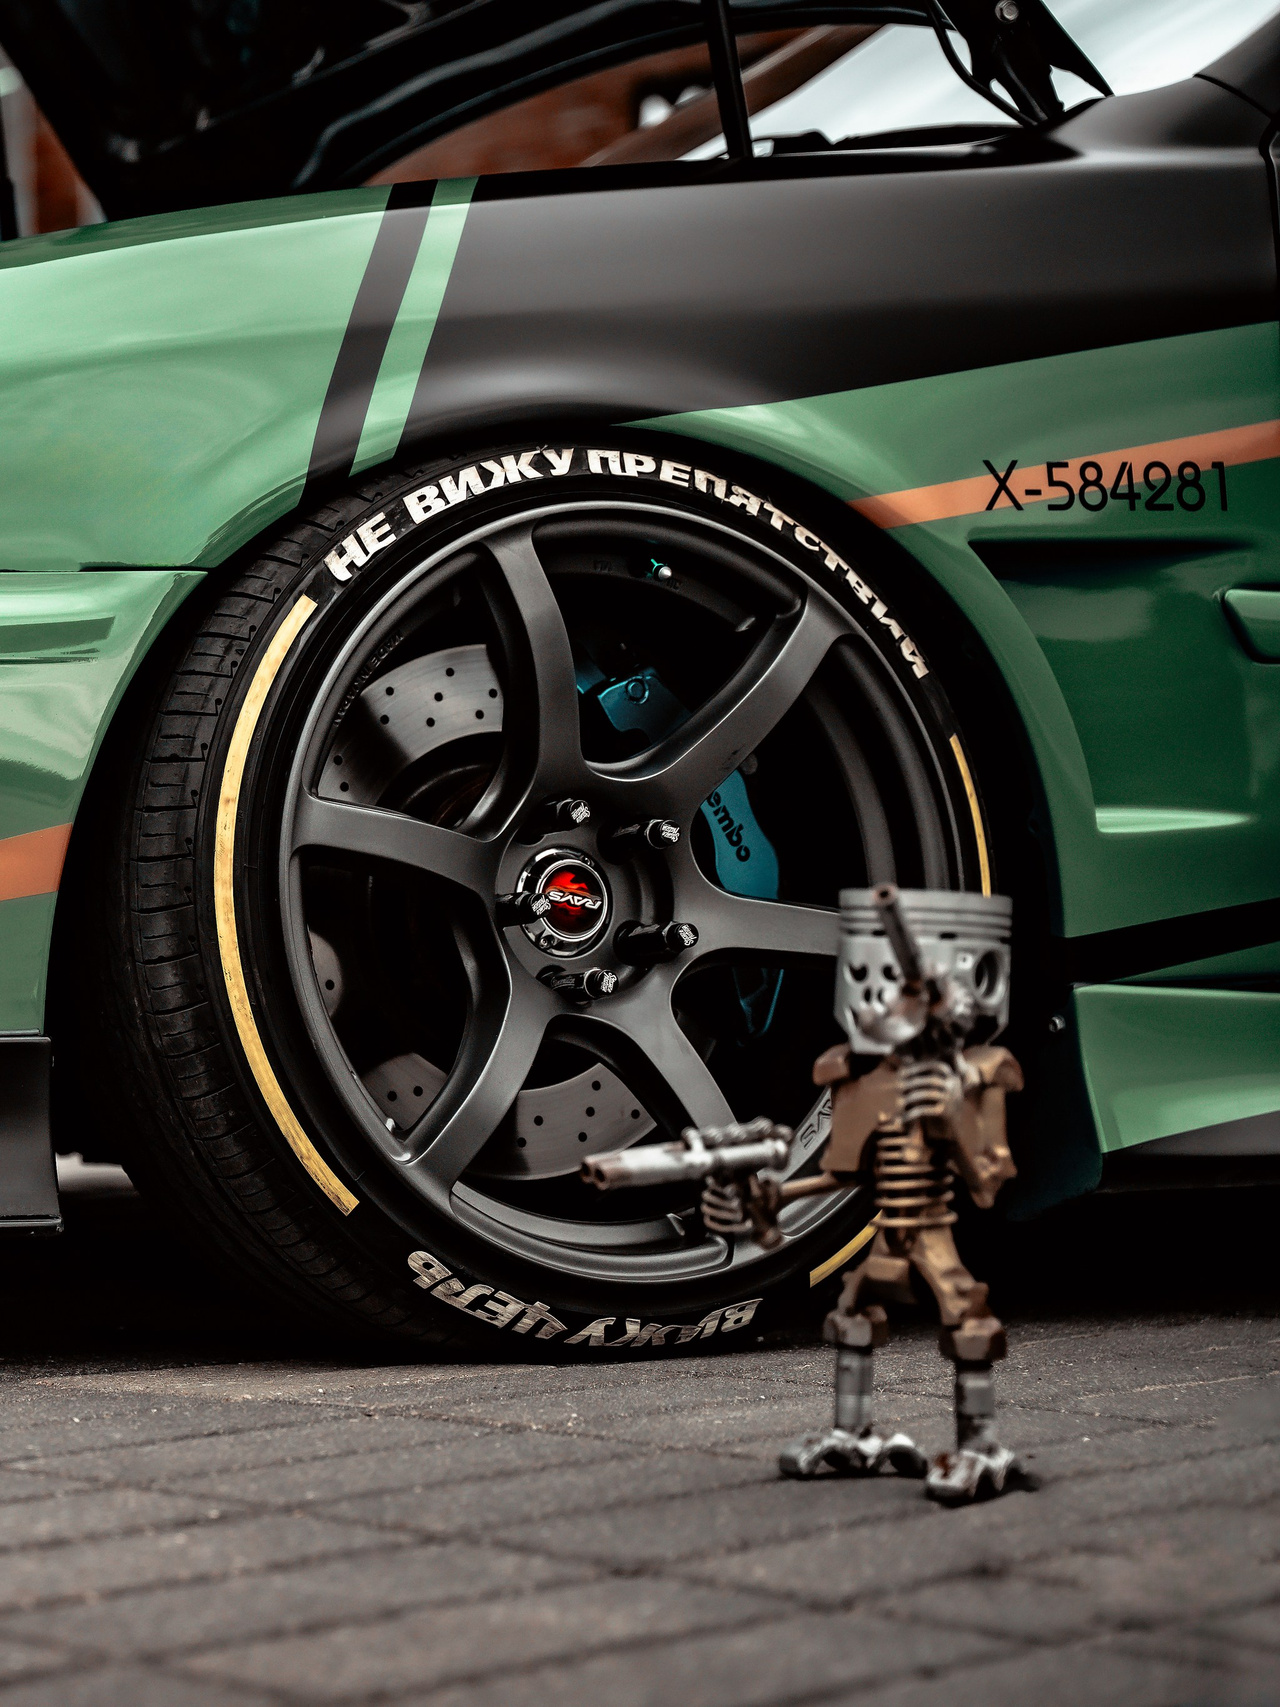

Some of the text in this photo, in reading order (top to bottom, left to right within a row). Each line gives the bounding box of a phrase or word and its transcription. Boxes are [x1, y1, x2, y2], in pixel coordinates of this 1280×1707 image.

[982, 459, 1228, 512] X-584281
[324, 447, 930, 679] НЕ ВИЖУ ПРЕПЯТСТВИЙ
[548, 890, 603, 911] RAYS
[407, 1251, 764, 1347] ВИЖУ ЦЕЛЬ
